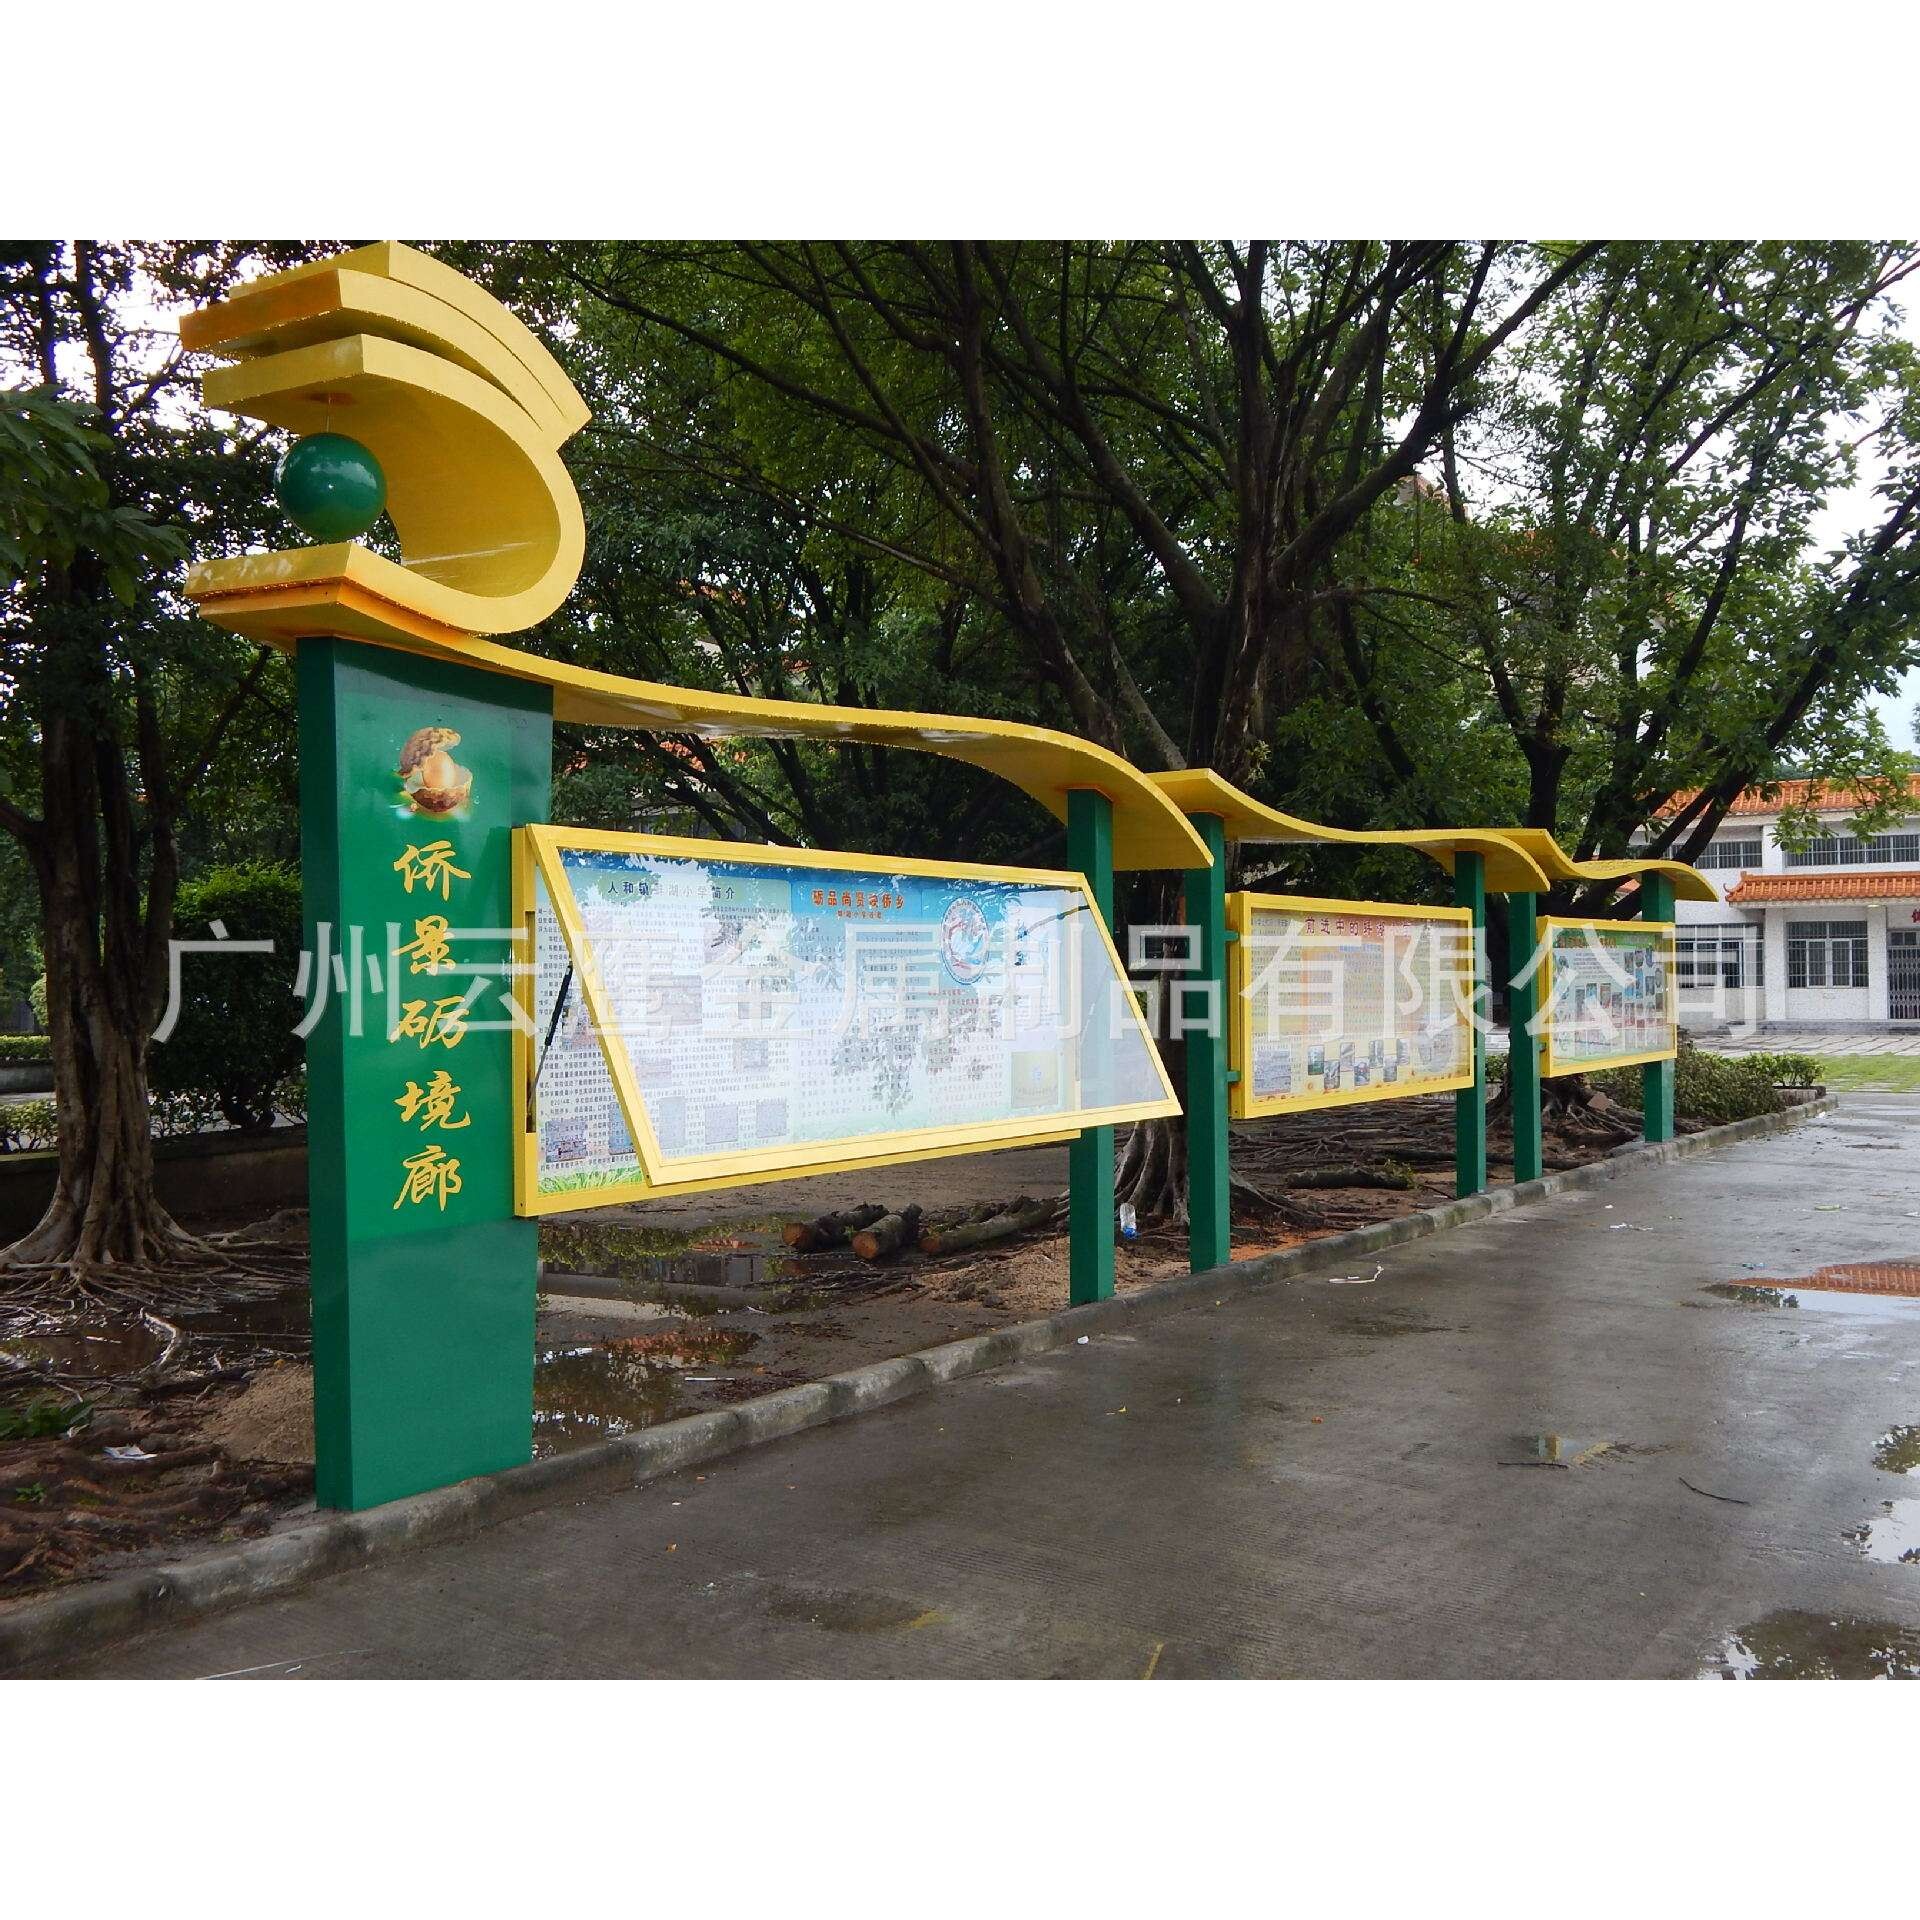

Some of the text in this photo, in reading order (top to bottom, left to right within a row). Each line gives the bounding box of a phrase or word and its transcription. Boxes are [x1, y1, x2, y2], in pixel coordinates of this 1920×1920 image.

[393, 840, 471, 1210] 侨景砺境廊
